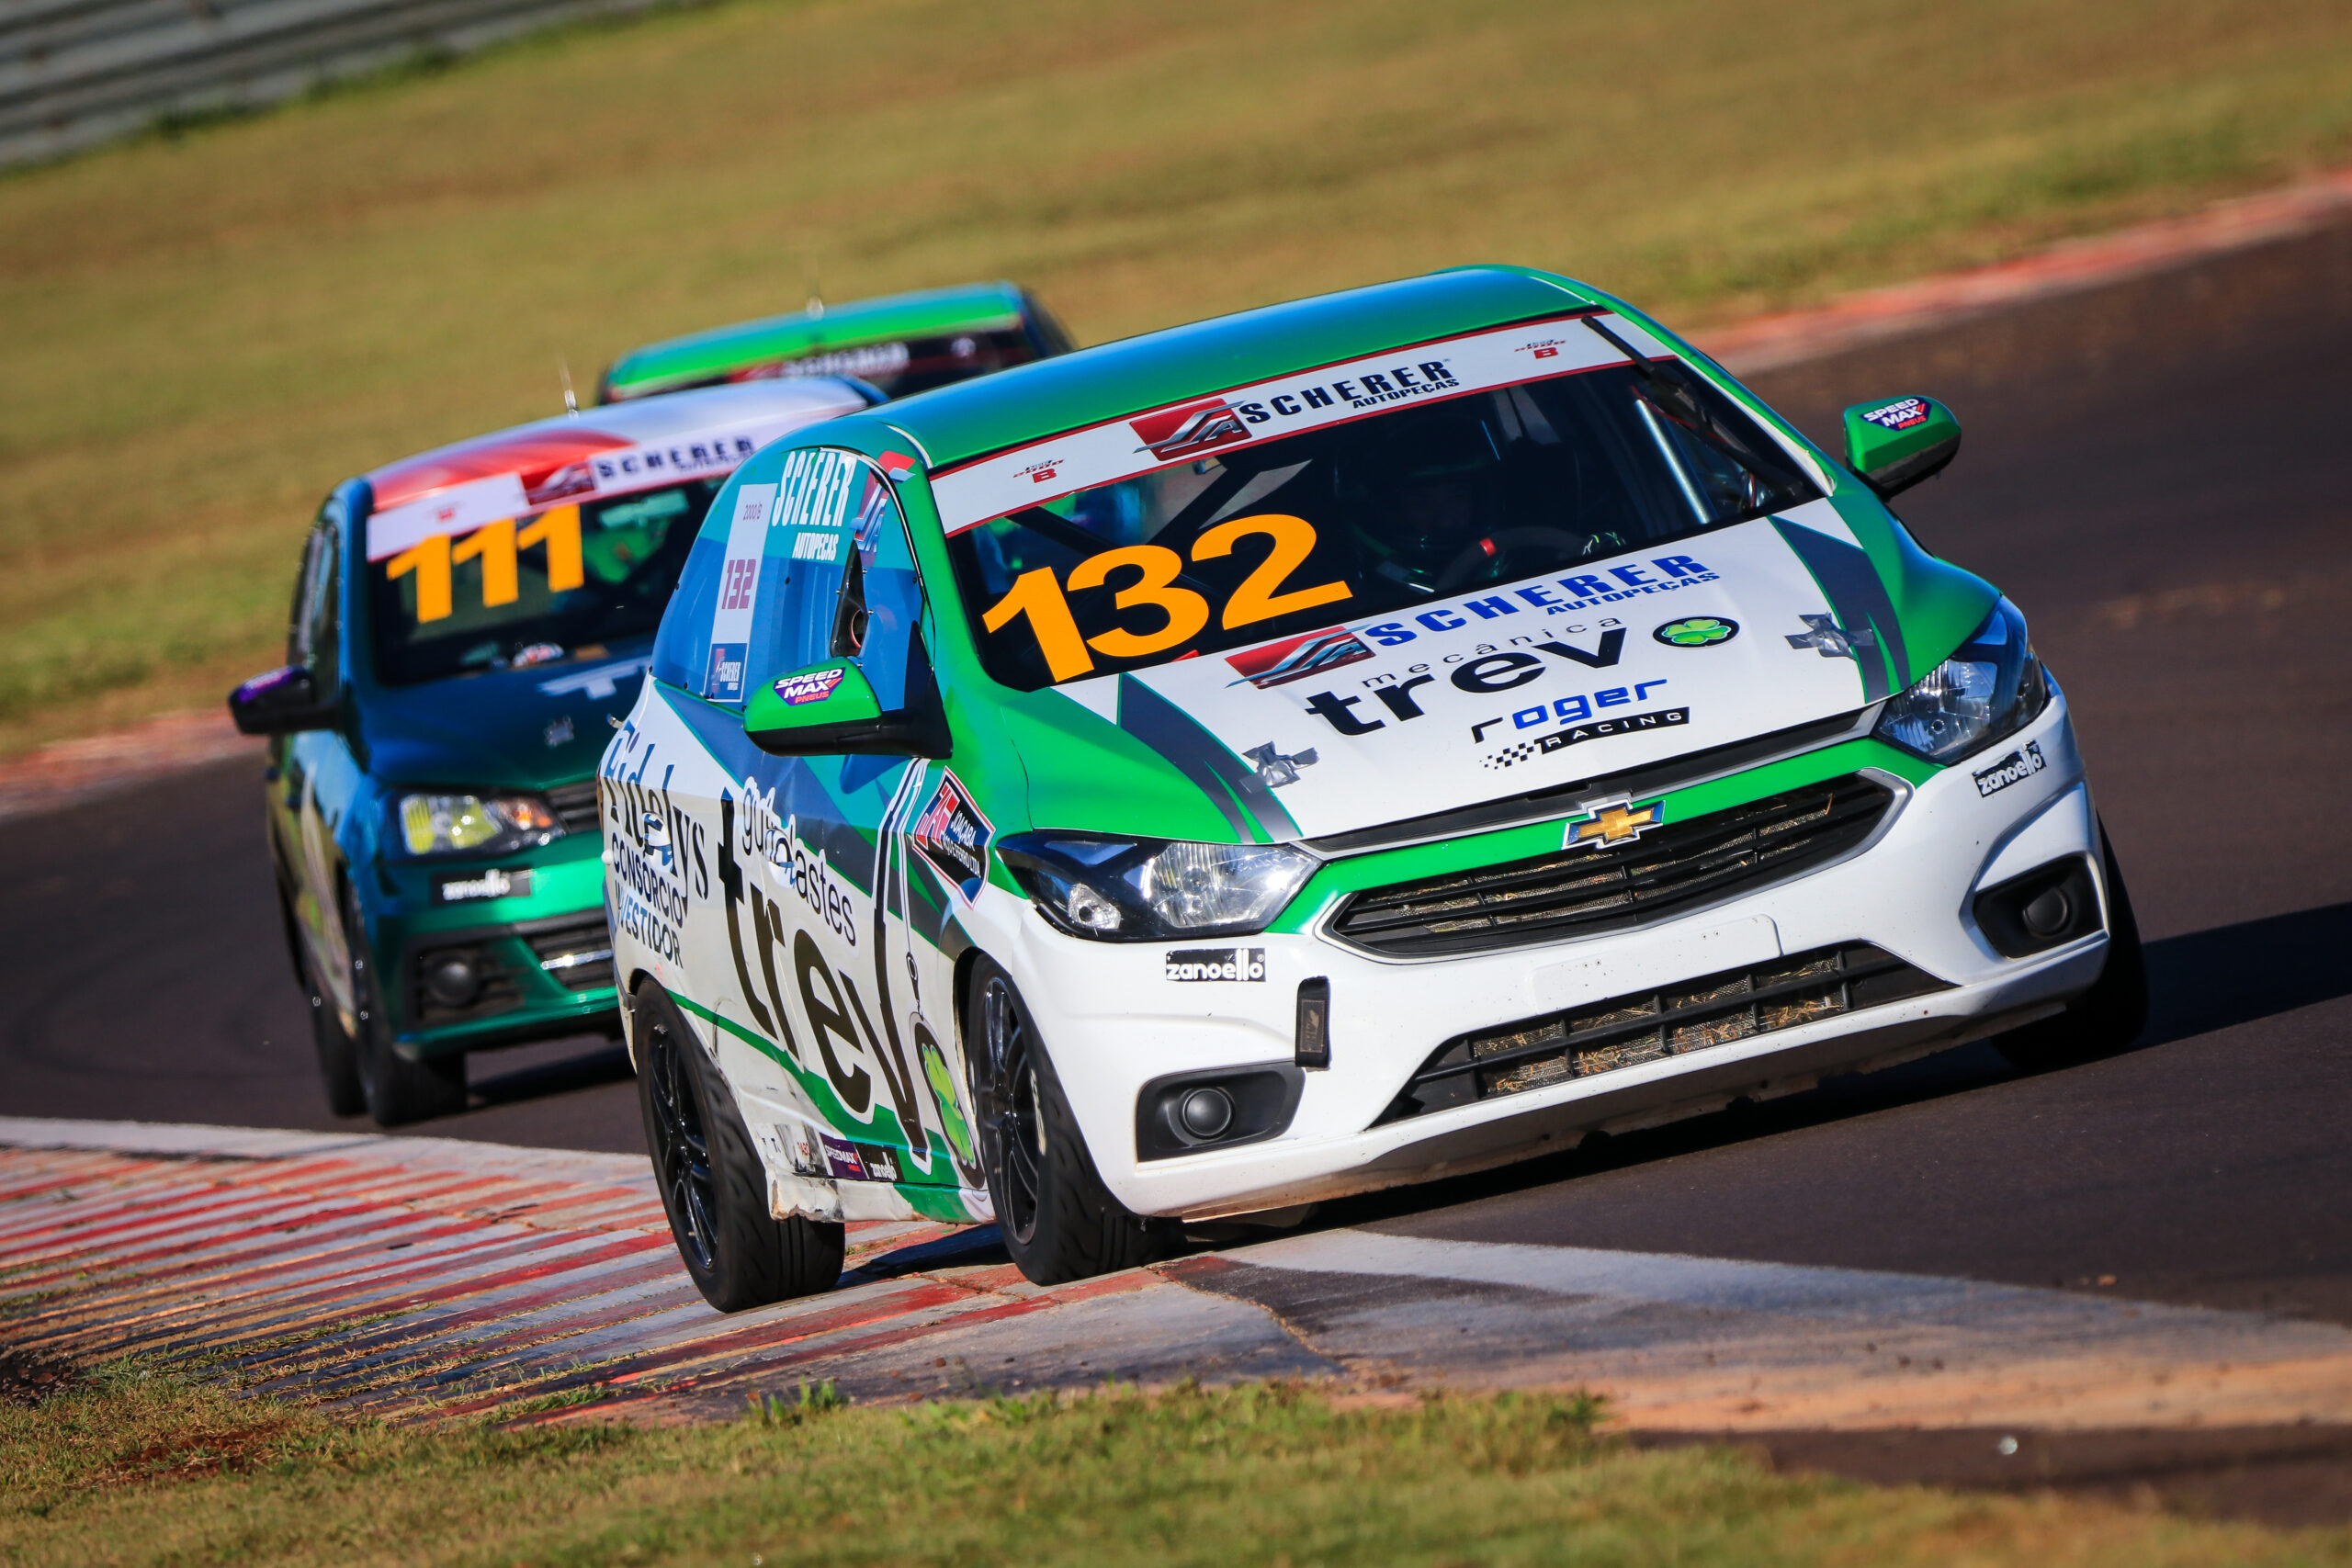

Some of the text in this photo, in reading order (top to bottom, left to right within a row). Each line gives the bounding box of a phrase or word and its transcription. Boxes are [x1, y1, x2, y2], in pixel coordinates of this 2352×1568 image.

[1533, 346, 1559, 359] B
[1239, 361, 1453, 423] SCHERER
[1352, 378, 1460, 410] AUTOPEÇAS
[1863, 399, 1919, 422] SPEED
[1882, 407, 1923, 427] MAX
[1897, 415, 1927, 430] PNEUS
[772, 451, 857, 526] SCHERER
[1032, 468, 1057, 483] B
[387, 502, 584, 624] 111
[721, 559, 756, 609] 132
[982, 513, 1353, 682] 132
[1364, 555, 1710, 647] SCHERER
[1547, 572, 1721, 615] AUTOPEÇAS
[1362, 617, 1623, 688] mecânica
[775, 669, 842, 689] SPEED
[784, 679, 831, 699] MAX
[795, 691, 830, 704] PNEUS
[1472, 679, 1667, 743] roger
[1545, 712, 1683, 748] RACING
[1978, 750, 2042, 795] zanoello
[1166, 948, 1264, 981] zanoello
